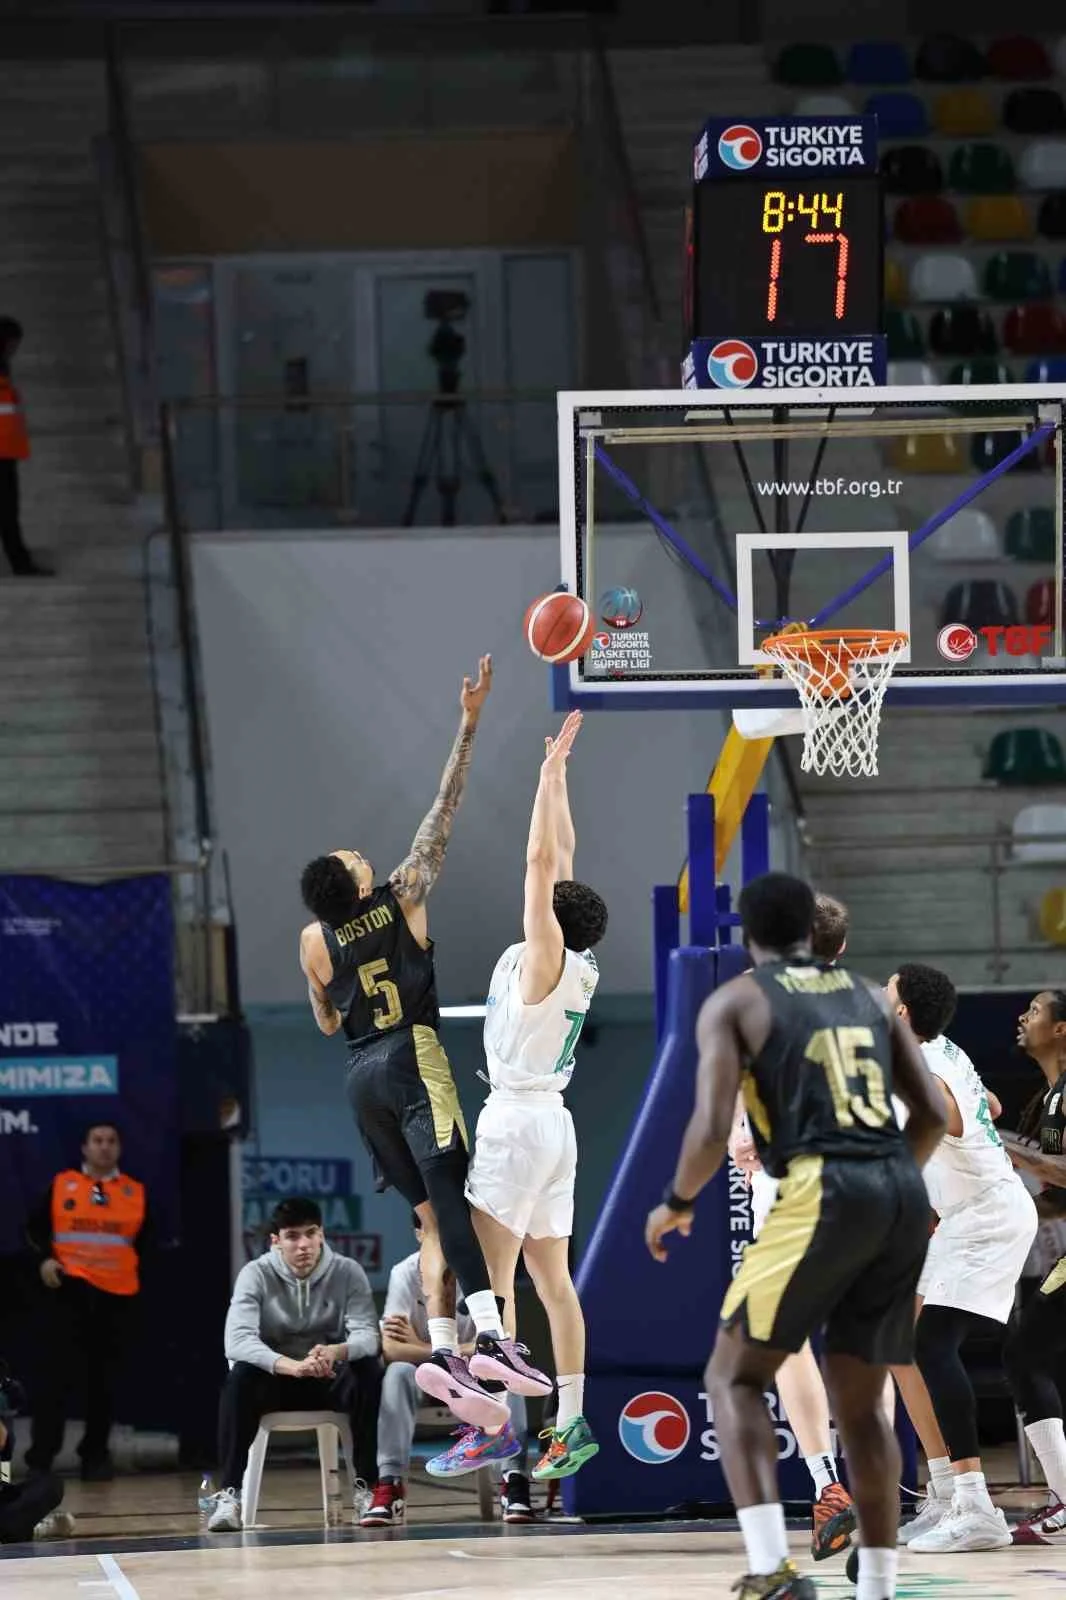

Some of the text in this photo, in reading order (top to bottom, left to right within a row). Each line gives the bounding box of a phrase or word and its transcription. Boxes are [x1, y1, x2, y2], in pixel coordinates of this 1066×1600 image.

[766, 147, 865, 166] SİGORTA
[762, 191, 843, 233] 8:44
[767, 233, 849, 322] 17
[762, 365, 876, 387] SİGORTA
[757, 477, 904, 498] www.tbf.org.tr
[591, 649, 653, 659] BASKETBOL
[980, 625, 1056, 656] TBF
[334, 904, 393, 947] BOSTON
[357, 957, 403, 1031] 5
[0, 1022, 59, 1047] NDE
[804, 1025, 892, 1129] 15
